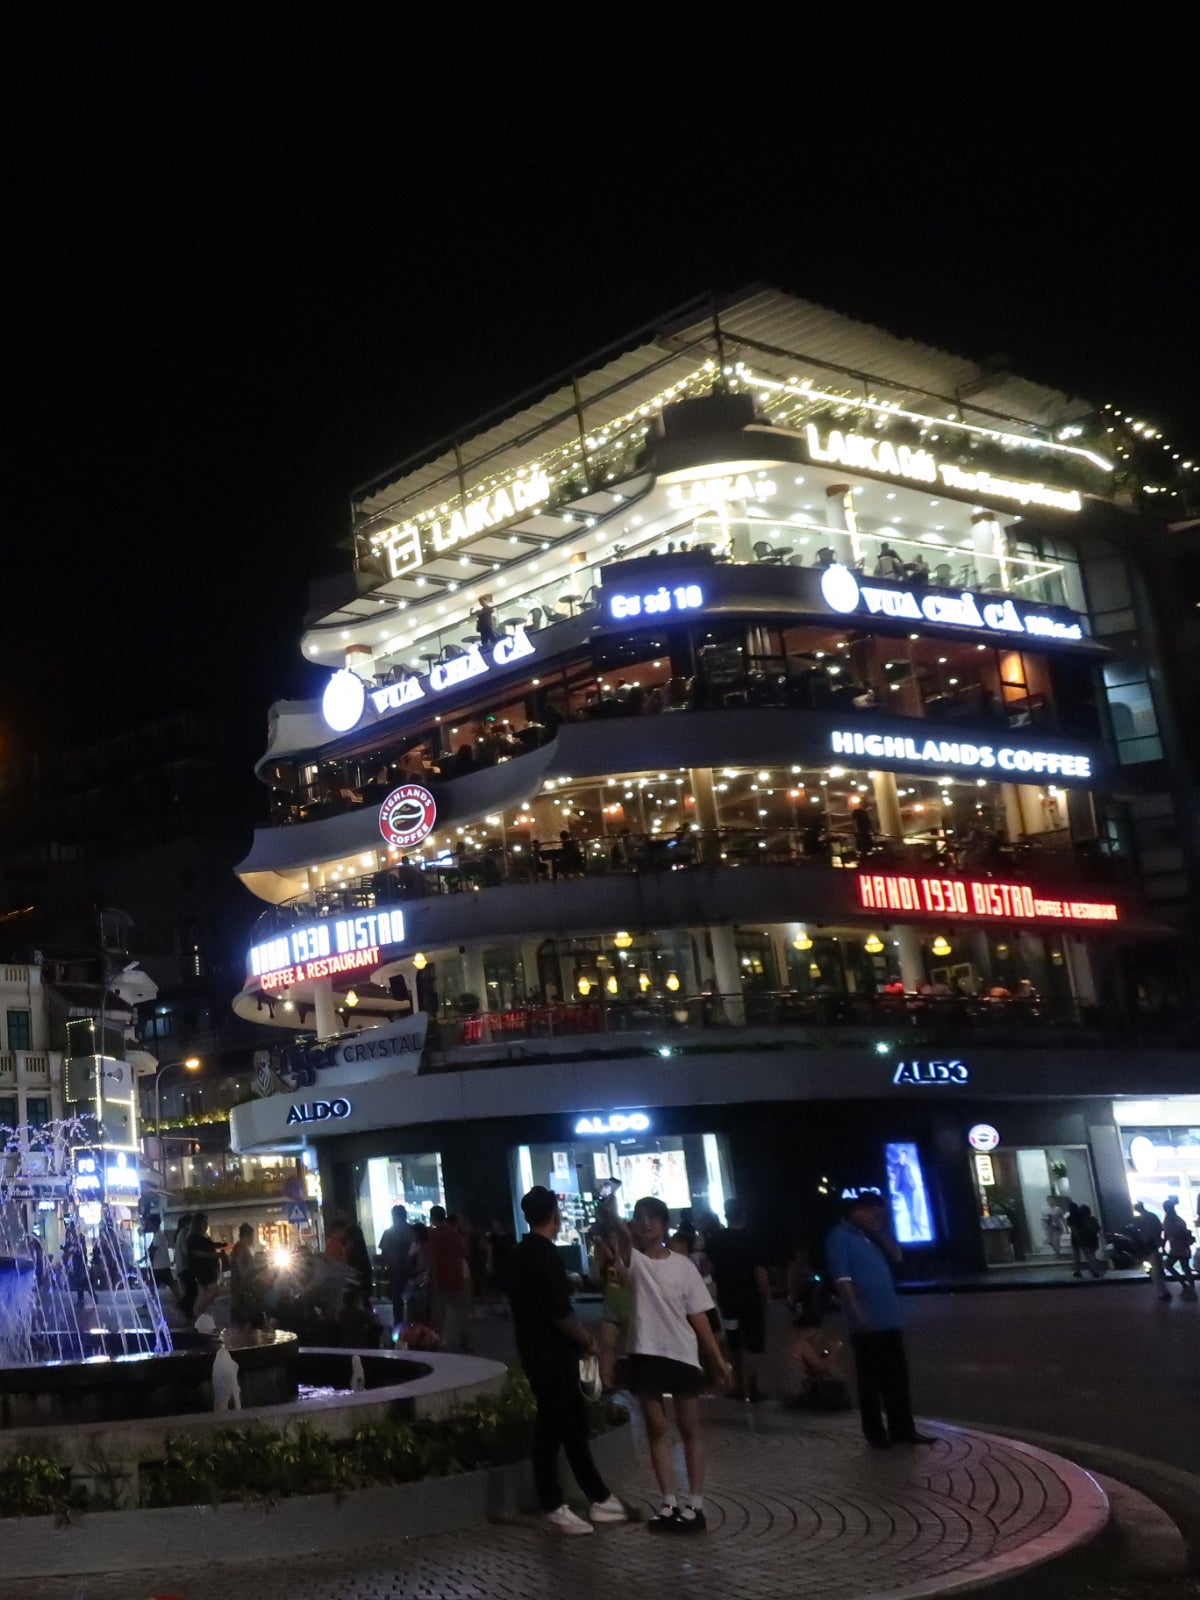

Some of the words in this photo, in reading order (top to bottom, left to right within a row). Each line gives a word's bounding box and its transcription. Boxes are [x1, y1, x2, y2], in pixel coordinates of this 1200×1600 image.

[860, 586, 923, 619] VUA
[371, 675, 425, 714] VUA
[831, 731, 996, 767] HIGHLANDS
[997, 748, 1091, 777] COFFEE
[382, 789, 432, 820] HIGHLANDS
[390, 823, 430, 843] COFFEE
[859, 875, 921, 910] HANOI
[921, 879, 968, 913] 1930
[971, 882, 1036, 917] BISTRO
[292, 925, 330, 963] 1930
[335, 910, 405, 953] BISTRO
[261, 968, 295, 990] COFFEE
[297, 966, 305, 981] &
[307, 947, 380, 979] RESTAURANT
[343, 1033, 422, 1063] CRYSTAL
[893, 1060, 969, 1085] ALDO
[286, 1097, 351, 1125] ALDO
[575, 1113, 650, 1135] ALDO
